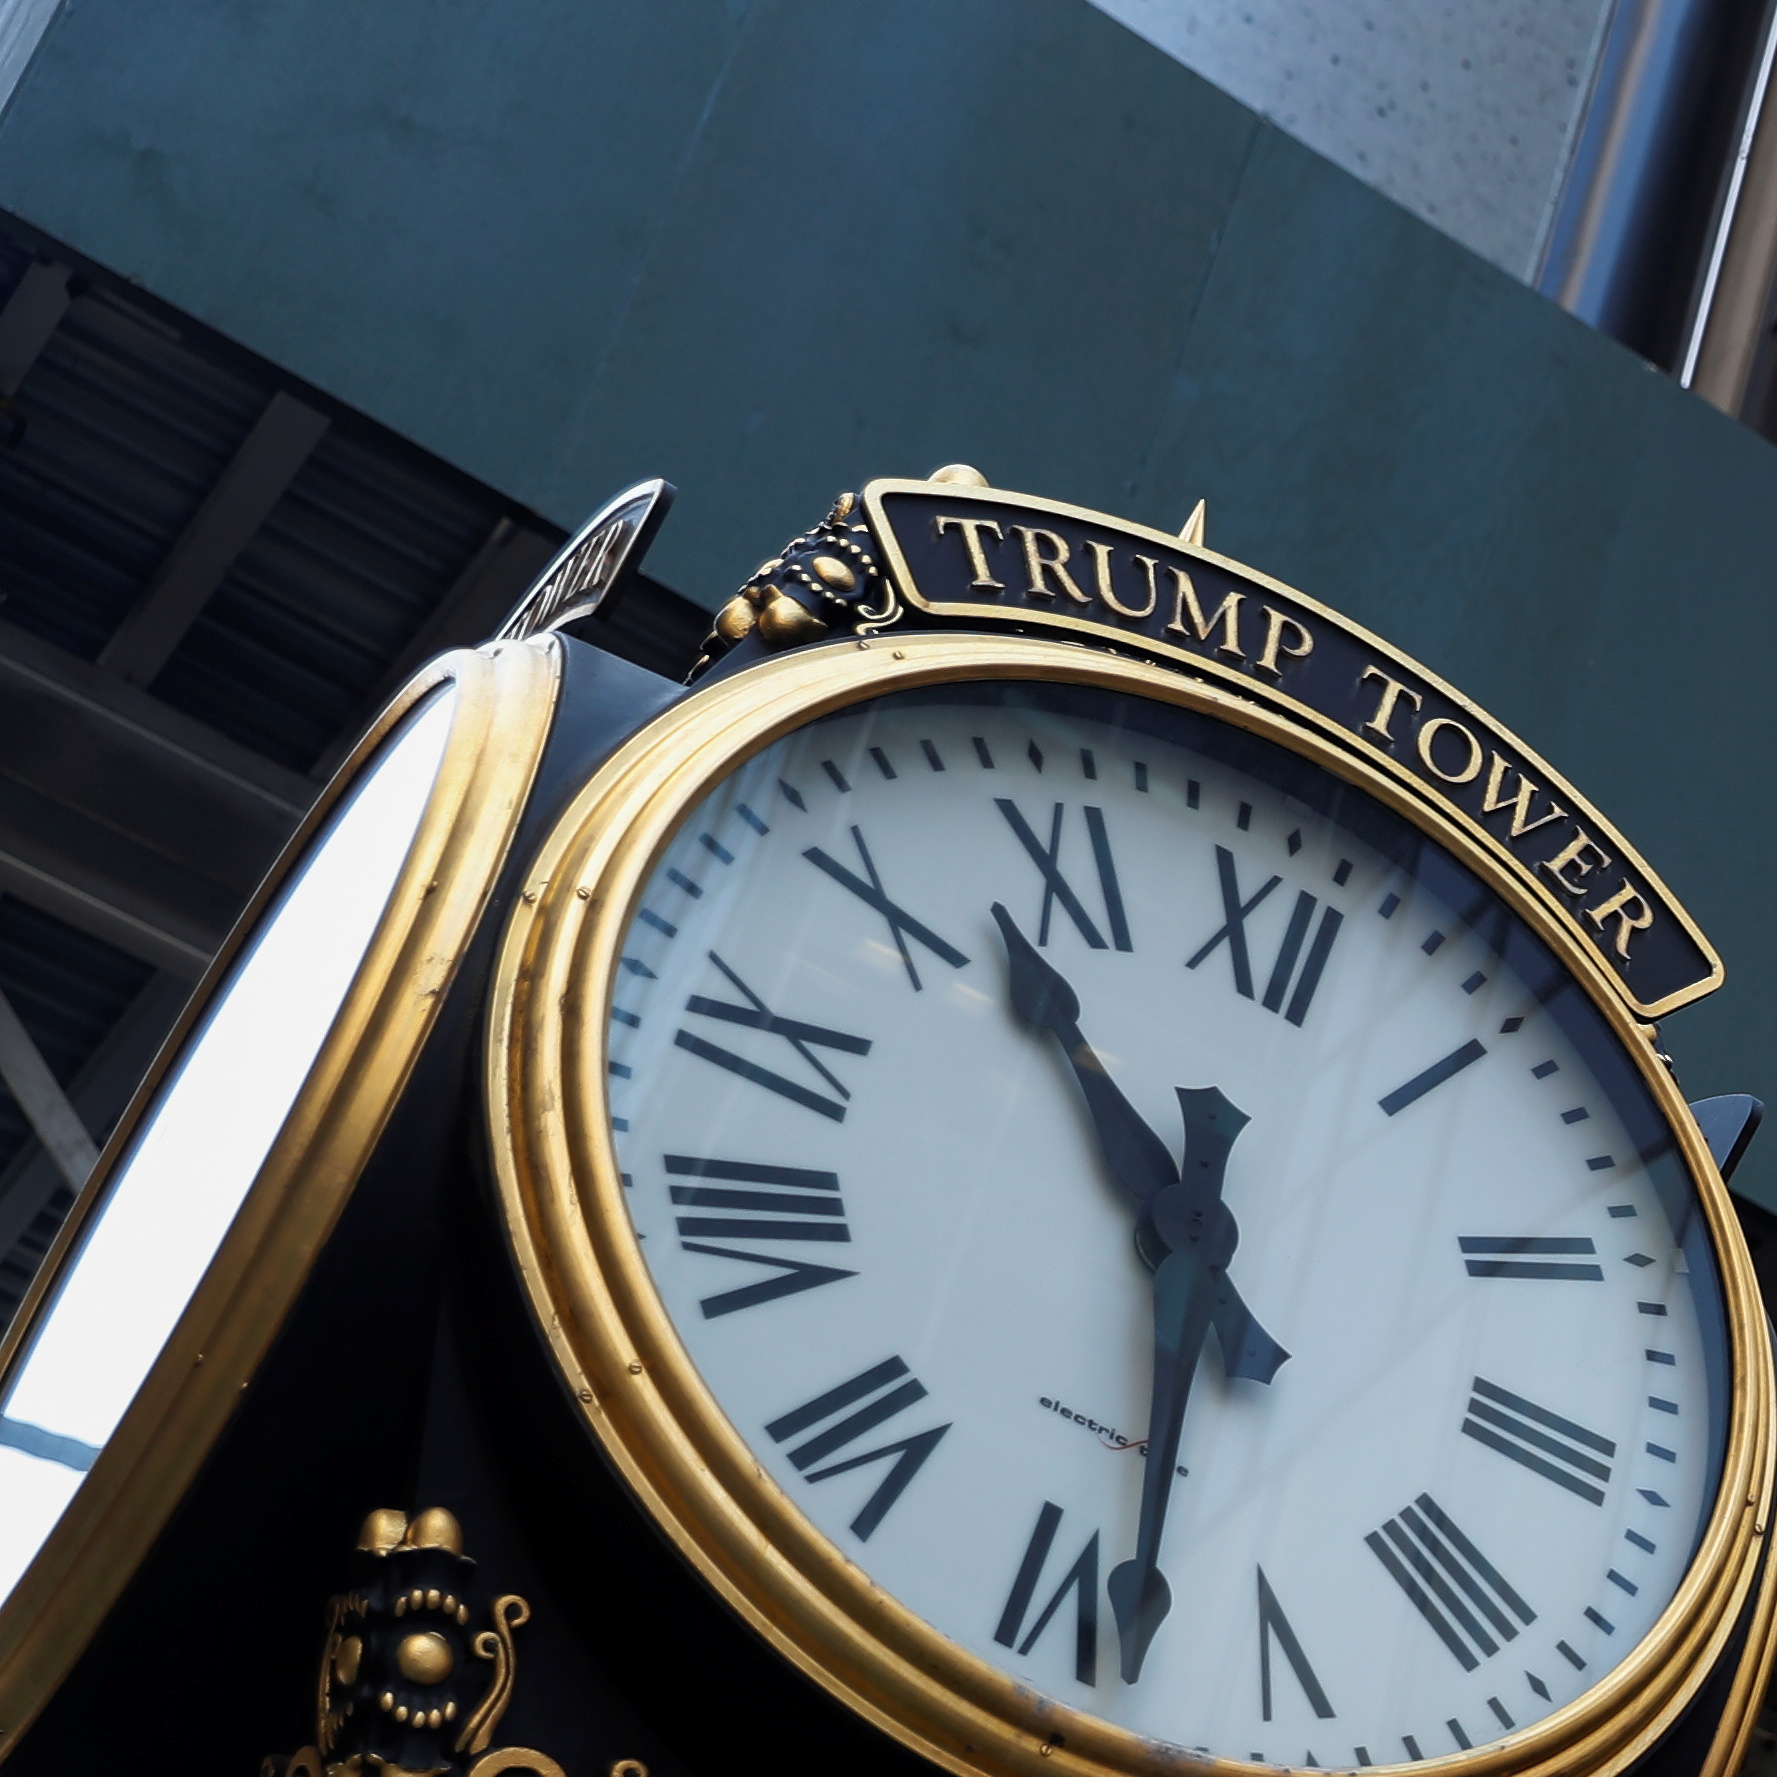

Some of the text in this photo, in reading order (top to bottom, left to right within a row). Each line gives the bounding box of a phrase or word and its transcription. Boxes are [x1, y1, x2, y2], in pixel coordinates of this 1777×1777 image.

[934, 515, 1657, 963] TRUMP TOWER
[801, 824, 972, 993] X
[993, 797, 1134, 953] XI
[1185, 843, 1345, 1029] XII
[673, 949, 873, 1125] IX
[1038, 1396, 1190, 1477] electric te
